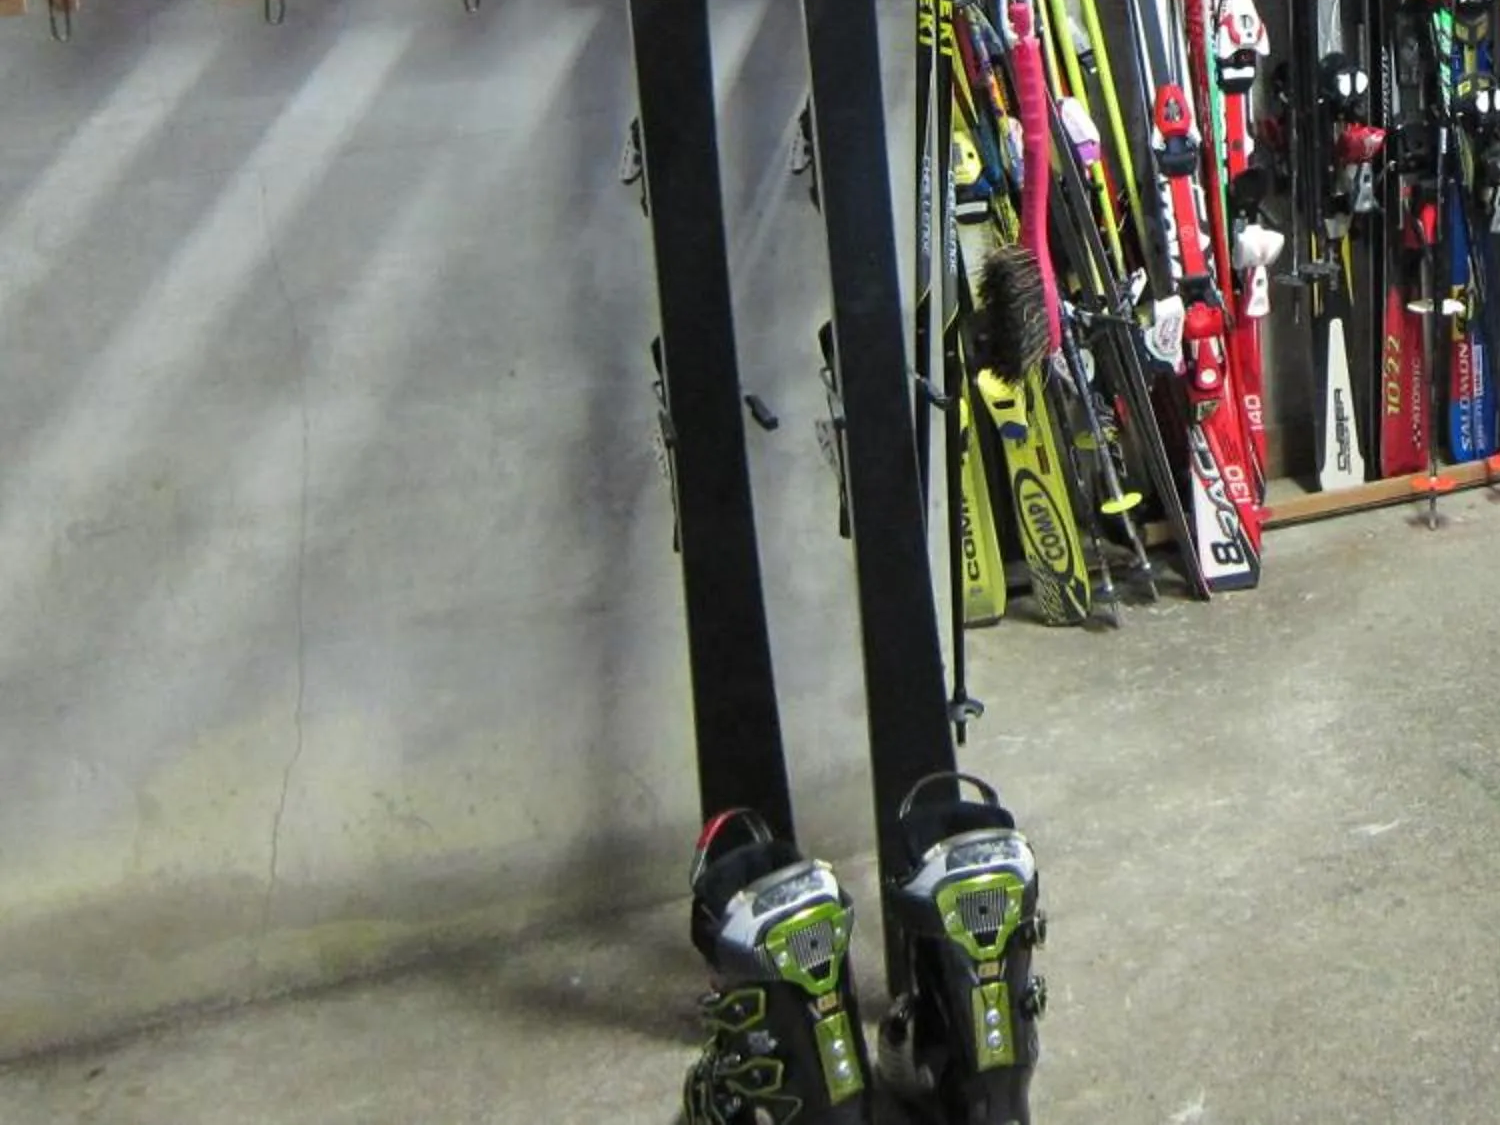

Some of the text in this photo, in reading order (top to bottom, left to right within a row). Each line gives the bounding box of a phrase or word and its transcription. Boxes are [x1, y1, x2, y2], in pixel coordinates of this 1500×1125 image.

[1243, 394, 1264, 431] 140
[1457, 342, 1474, 452] SALOMON
[1223, 465, 1252, 505] 130
[1209, 541, 1246, 566] 8
